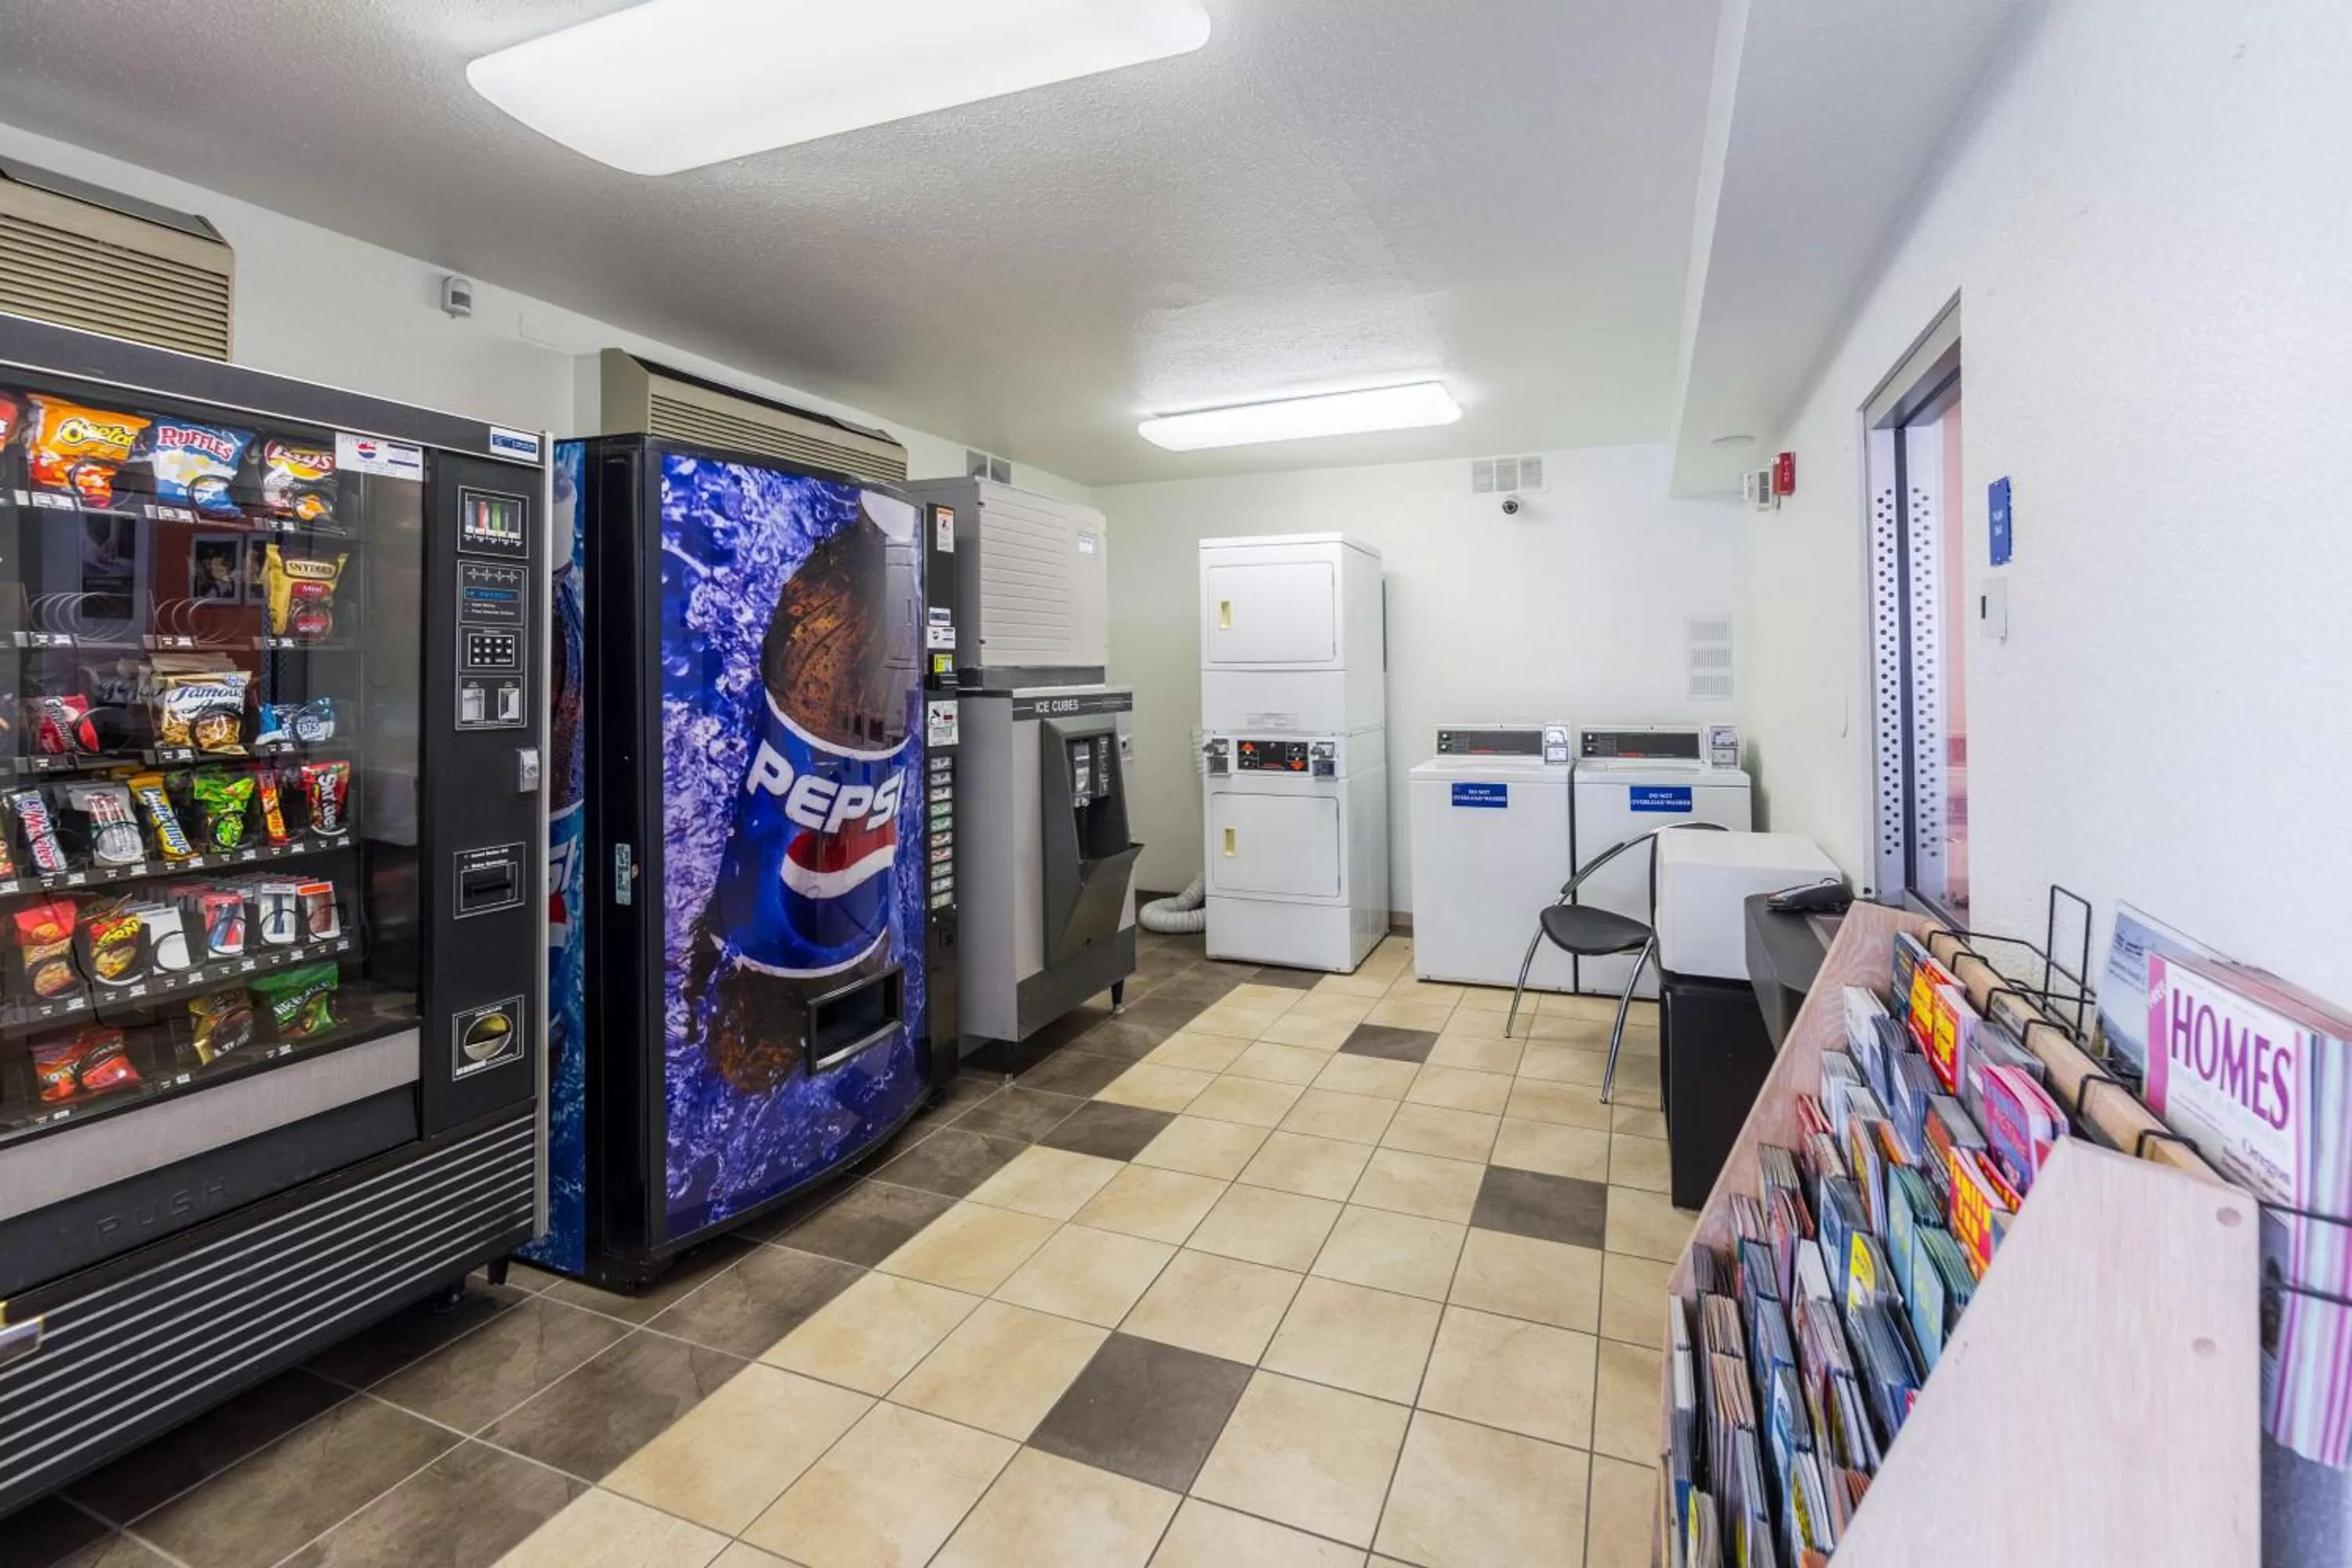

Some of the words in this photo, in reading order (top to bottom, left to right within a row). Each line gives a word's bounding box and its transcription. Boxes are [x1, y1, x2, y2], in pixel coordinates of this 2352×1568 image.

[158, 426, 234, 461] RUFFLES
[1035, 701, 1050, 713] ICE
[1051, 699, 1080, 712] CUBES
[746, 739, 906, 834] PEPSI
[2171, 988, 2292, 1131] HOMES
[96, 1176, 227, 1245] PUSH
